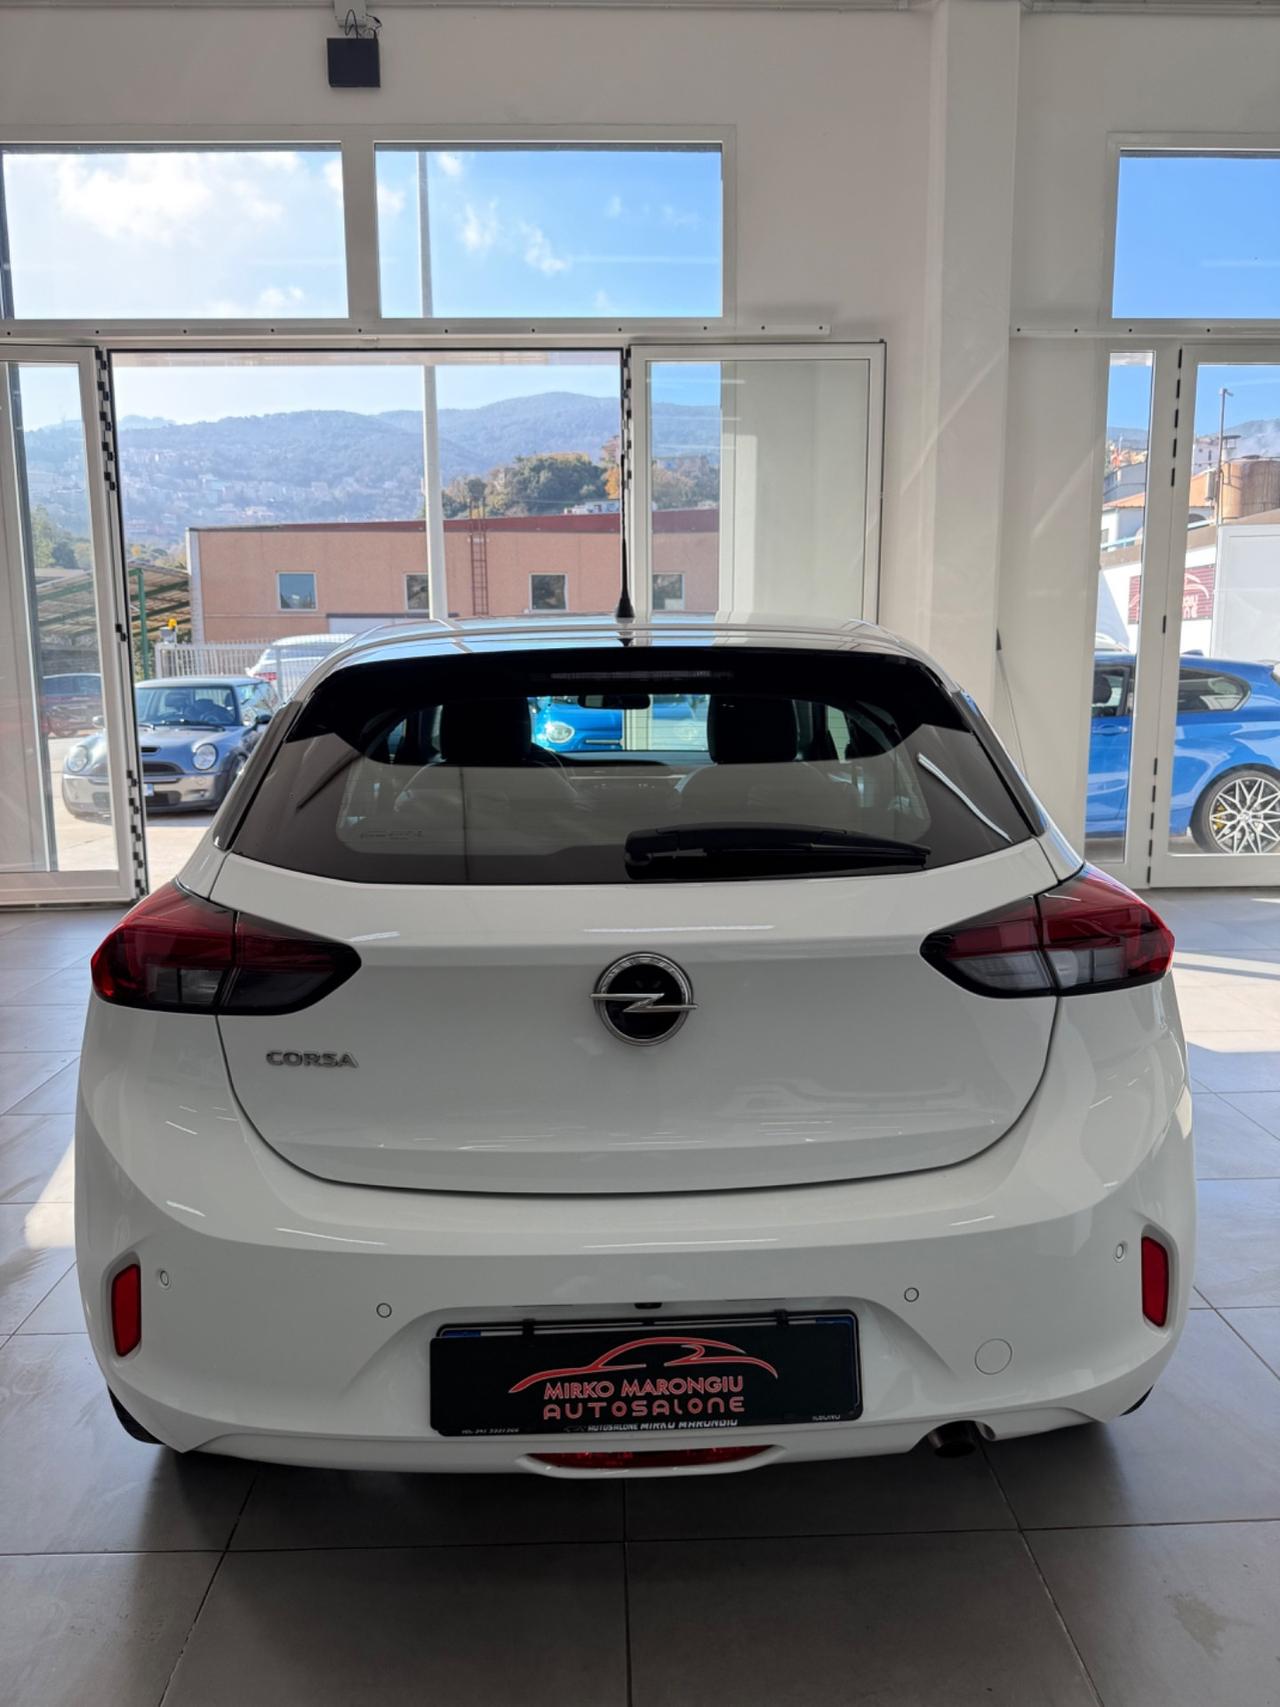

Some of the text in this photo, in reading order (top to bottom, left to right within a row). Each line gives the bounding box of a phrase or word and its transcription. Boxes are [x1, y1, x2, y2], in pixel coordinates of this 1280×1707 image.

[266, 1050, 358, 1068] CORSA
[543, 1375, 744, 1399] MIRKO MARONGIU
[543, 1396, 745, 1420] AUTOSALONE
